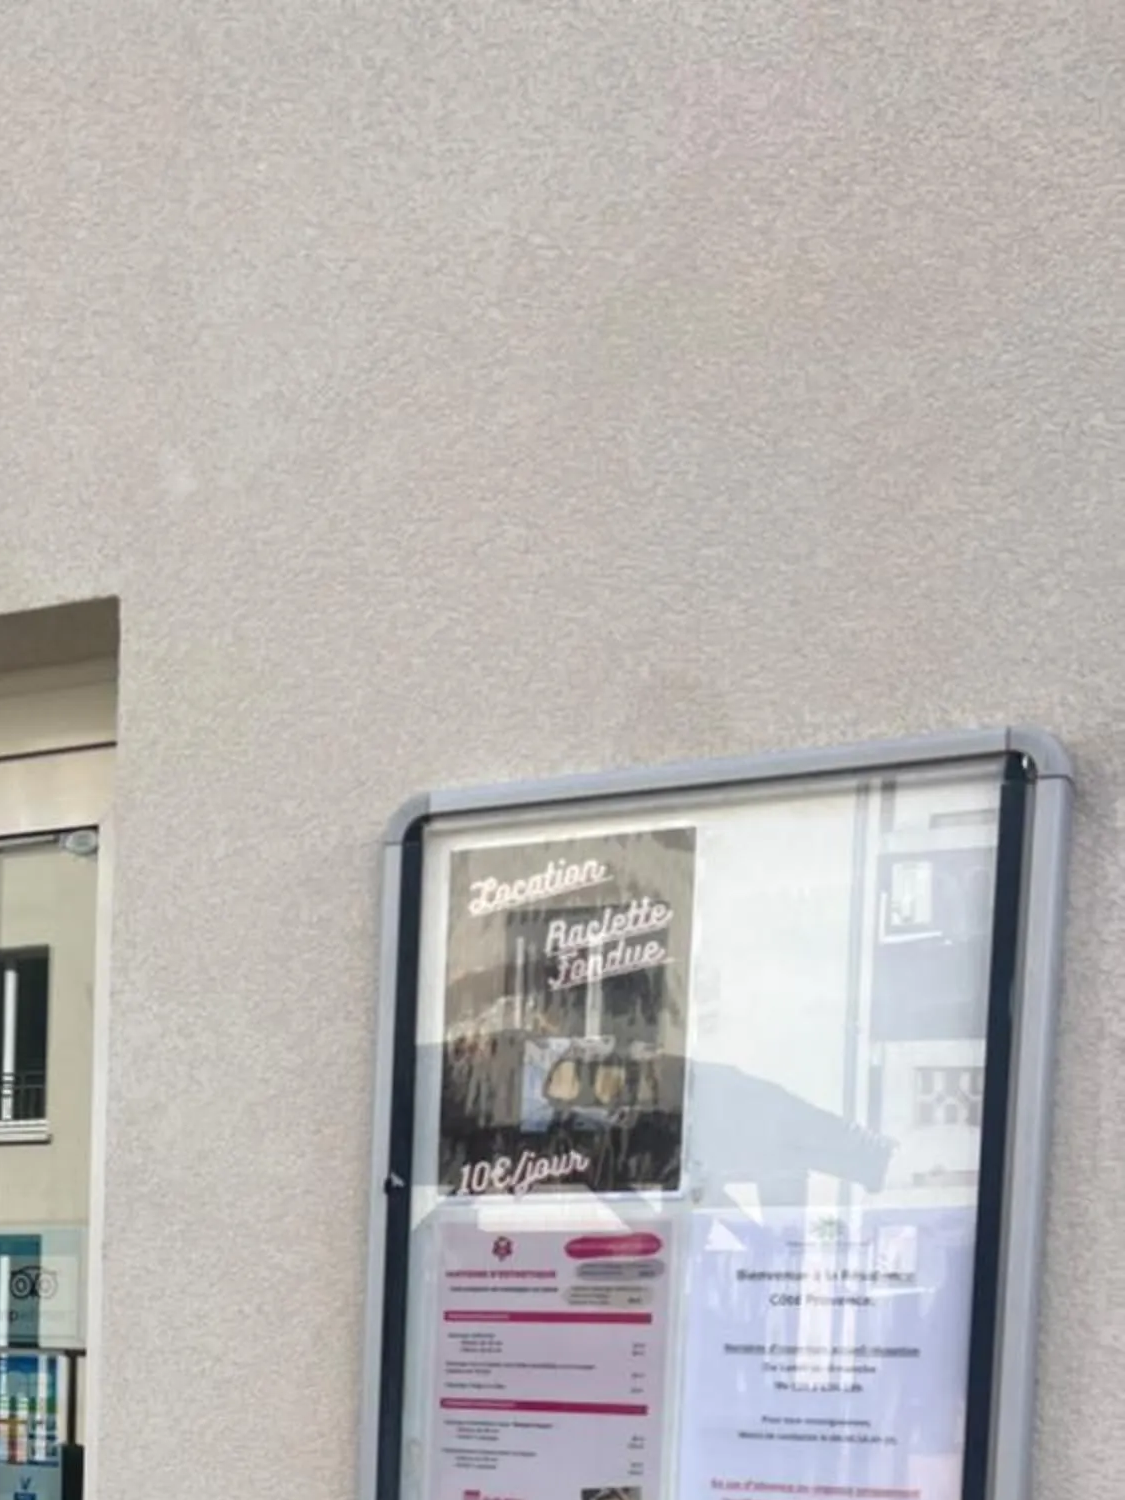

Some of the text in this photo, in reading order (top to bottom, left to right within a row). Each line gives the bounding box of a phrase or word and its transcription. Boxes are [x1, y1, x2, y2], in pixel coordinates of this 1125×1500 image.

[468, 857, 615, 918] Location
[545, 896, 674, 958] Raclette
[547, 939, 676, 992] Fondue
[455, 1147, 593, 1199] 10€/jour
